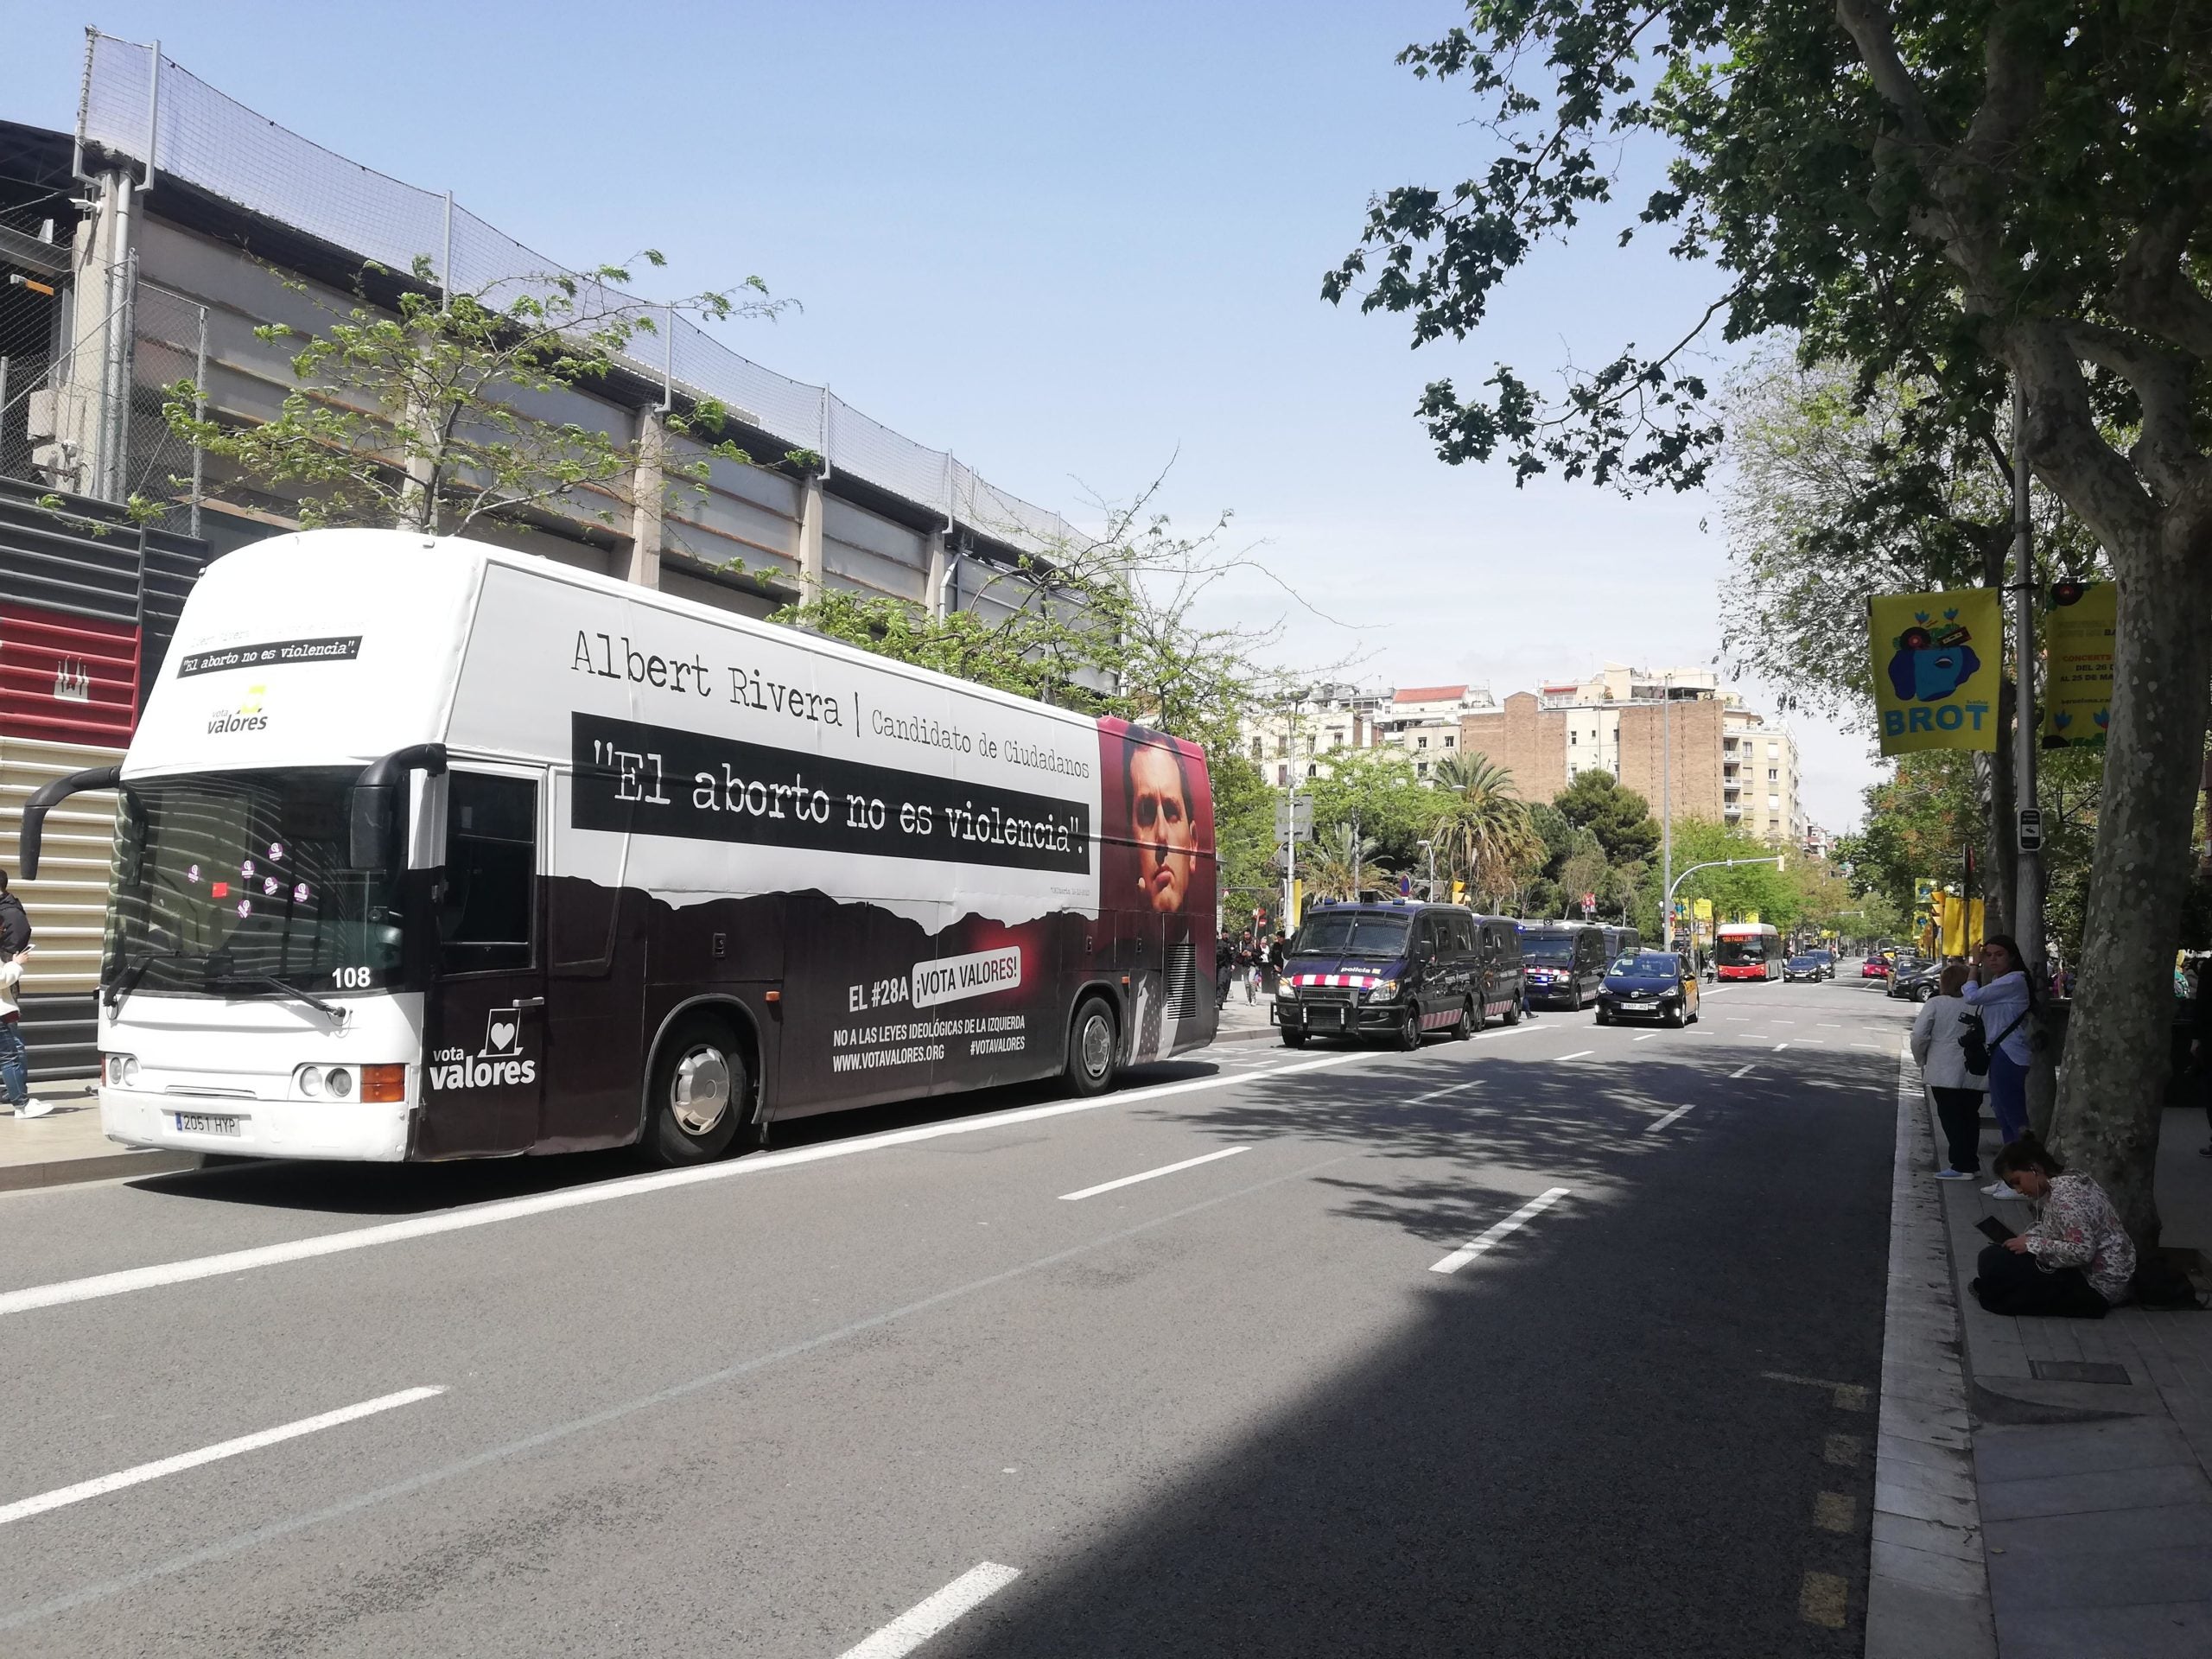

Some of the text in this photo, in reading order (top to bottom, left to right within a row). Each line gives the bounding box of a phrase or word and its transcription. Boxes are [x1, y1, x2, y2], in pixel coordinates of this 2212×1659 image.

[183, 658, 197, 671] "El
[200, 652, 238, 669] aborto
[241, 651, 257, 663] no
[261, 649, 276, 660] es
[212, 709, 229, 718] vota
[570, 630, 1090, 779] Albert Rivera Candidato de Ciudadanos
[1885, 704, 1989, 736] BROT
[207, 715, 268, 734] valores
[594, 740, 1083, 854] "El aborto no es violencia".
[331, 967, 371, 988] 108
[849, 956, 1017, 1013] EL #28A ¡VOTA VALORES!
[834, 1015, 1026, 1046] NO A LAS LEYES IDEOLÓGICAS DE LA IZQUIERDA
[433, 1046, 464, 1062] vota
[833, 1036, 1026, 1072] WWW.VOTAVALORES.ORG #VOTAVALORES
[429, 1055, 536, 1090] valores
[184, 1115, 235, 1134] 2051 HYP
